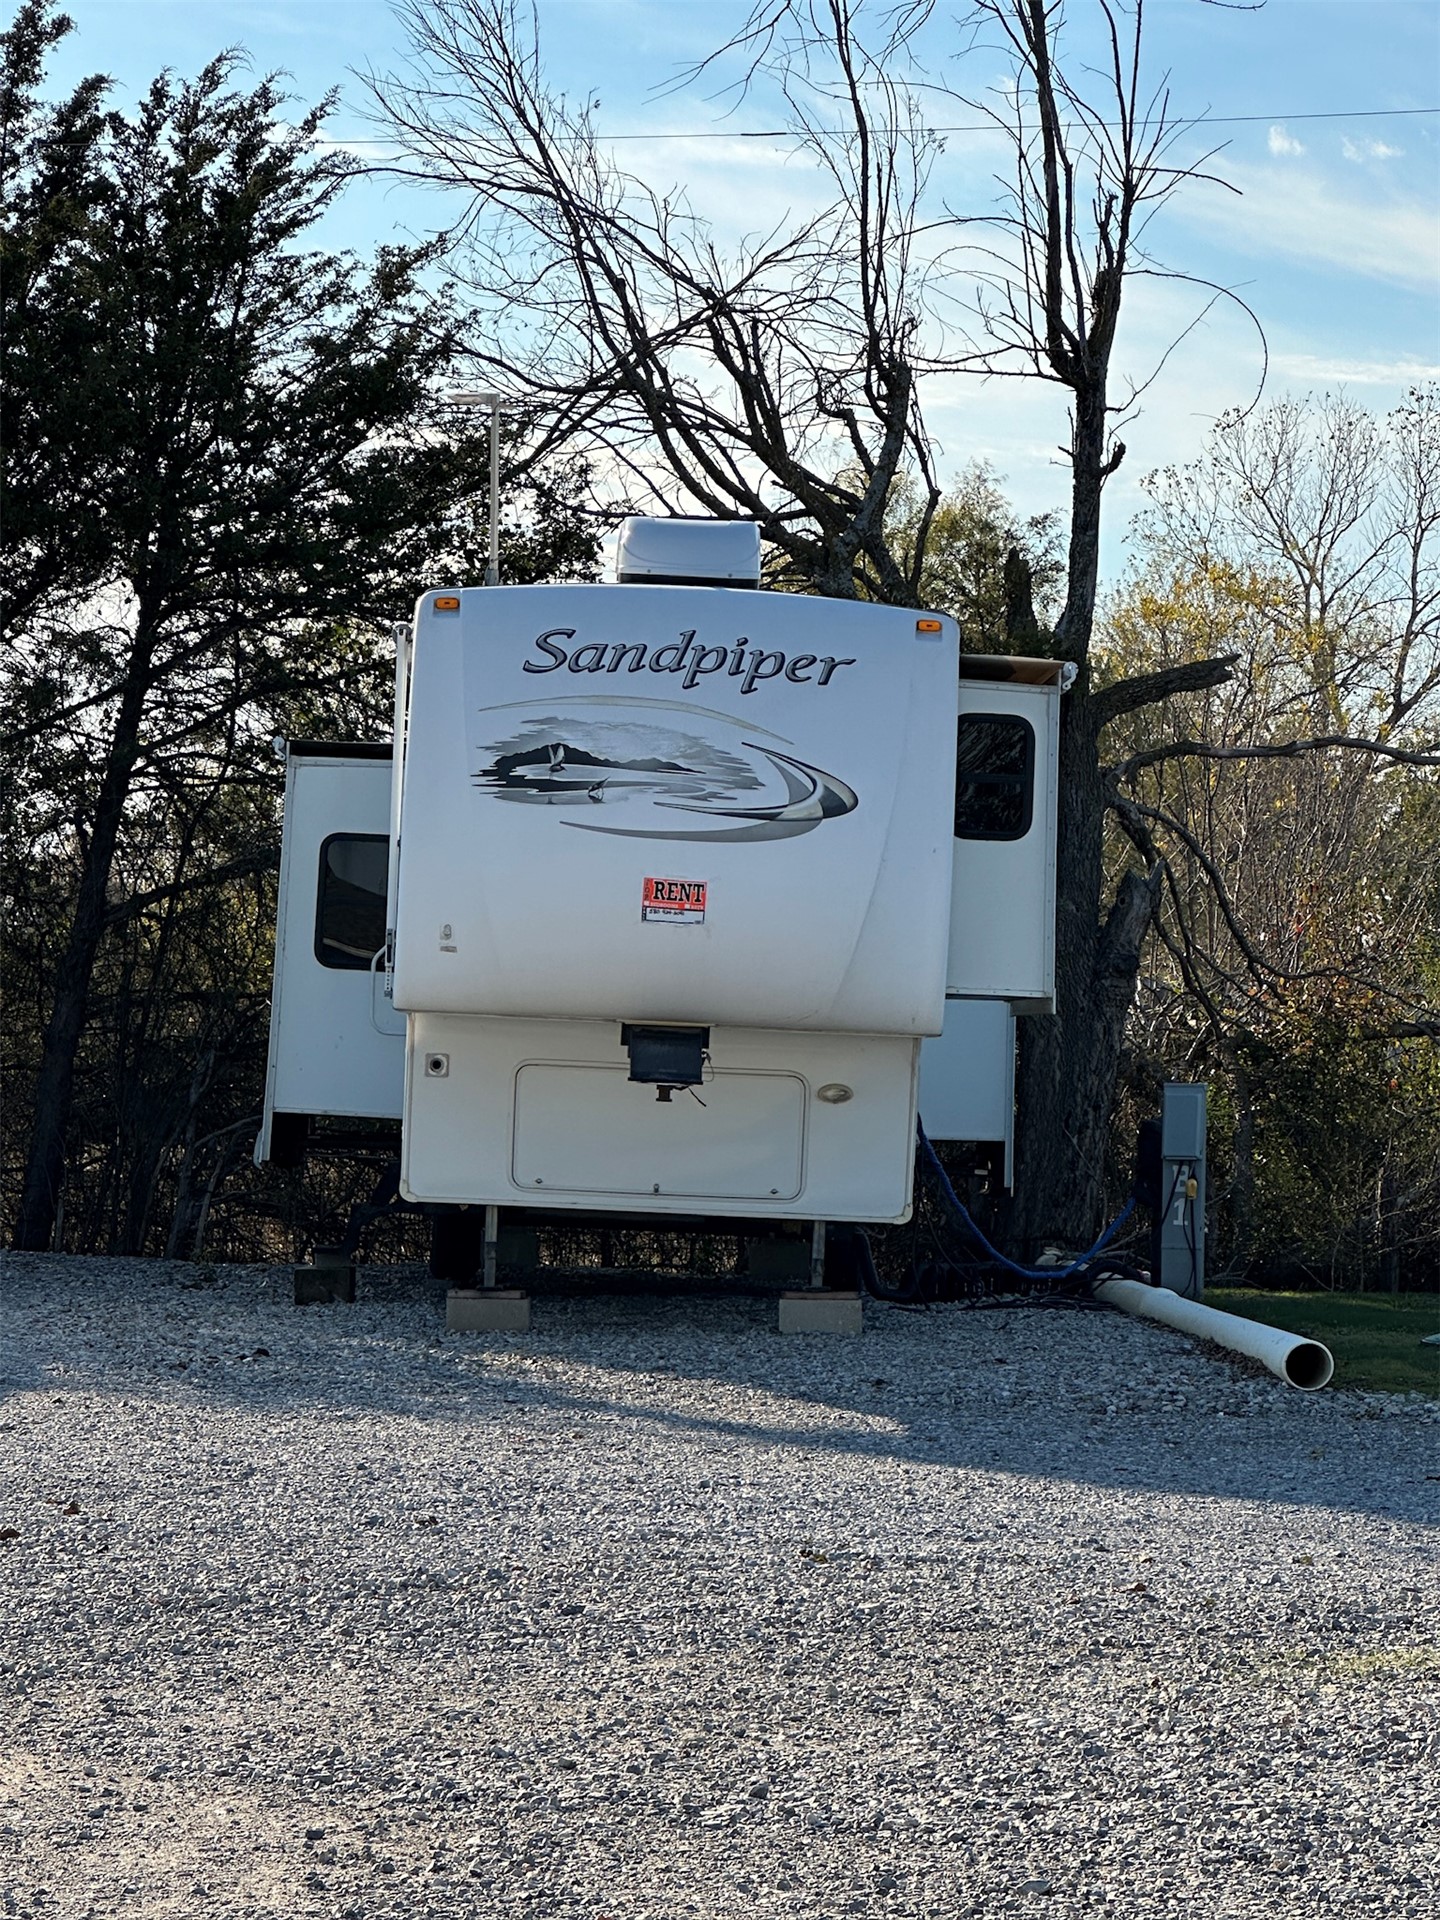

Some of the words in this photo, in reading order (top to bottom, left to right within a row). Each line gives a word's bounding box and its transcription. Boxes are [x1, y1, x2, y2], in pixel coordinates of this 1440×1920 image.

[523, 628, 856, 694] Sandpiper
[653, 881, 705, 903] RENT
[1173, 1198, 1189, 1225] 1
